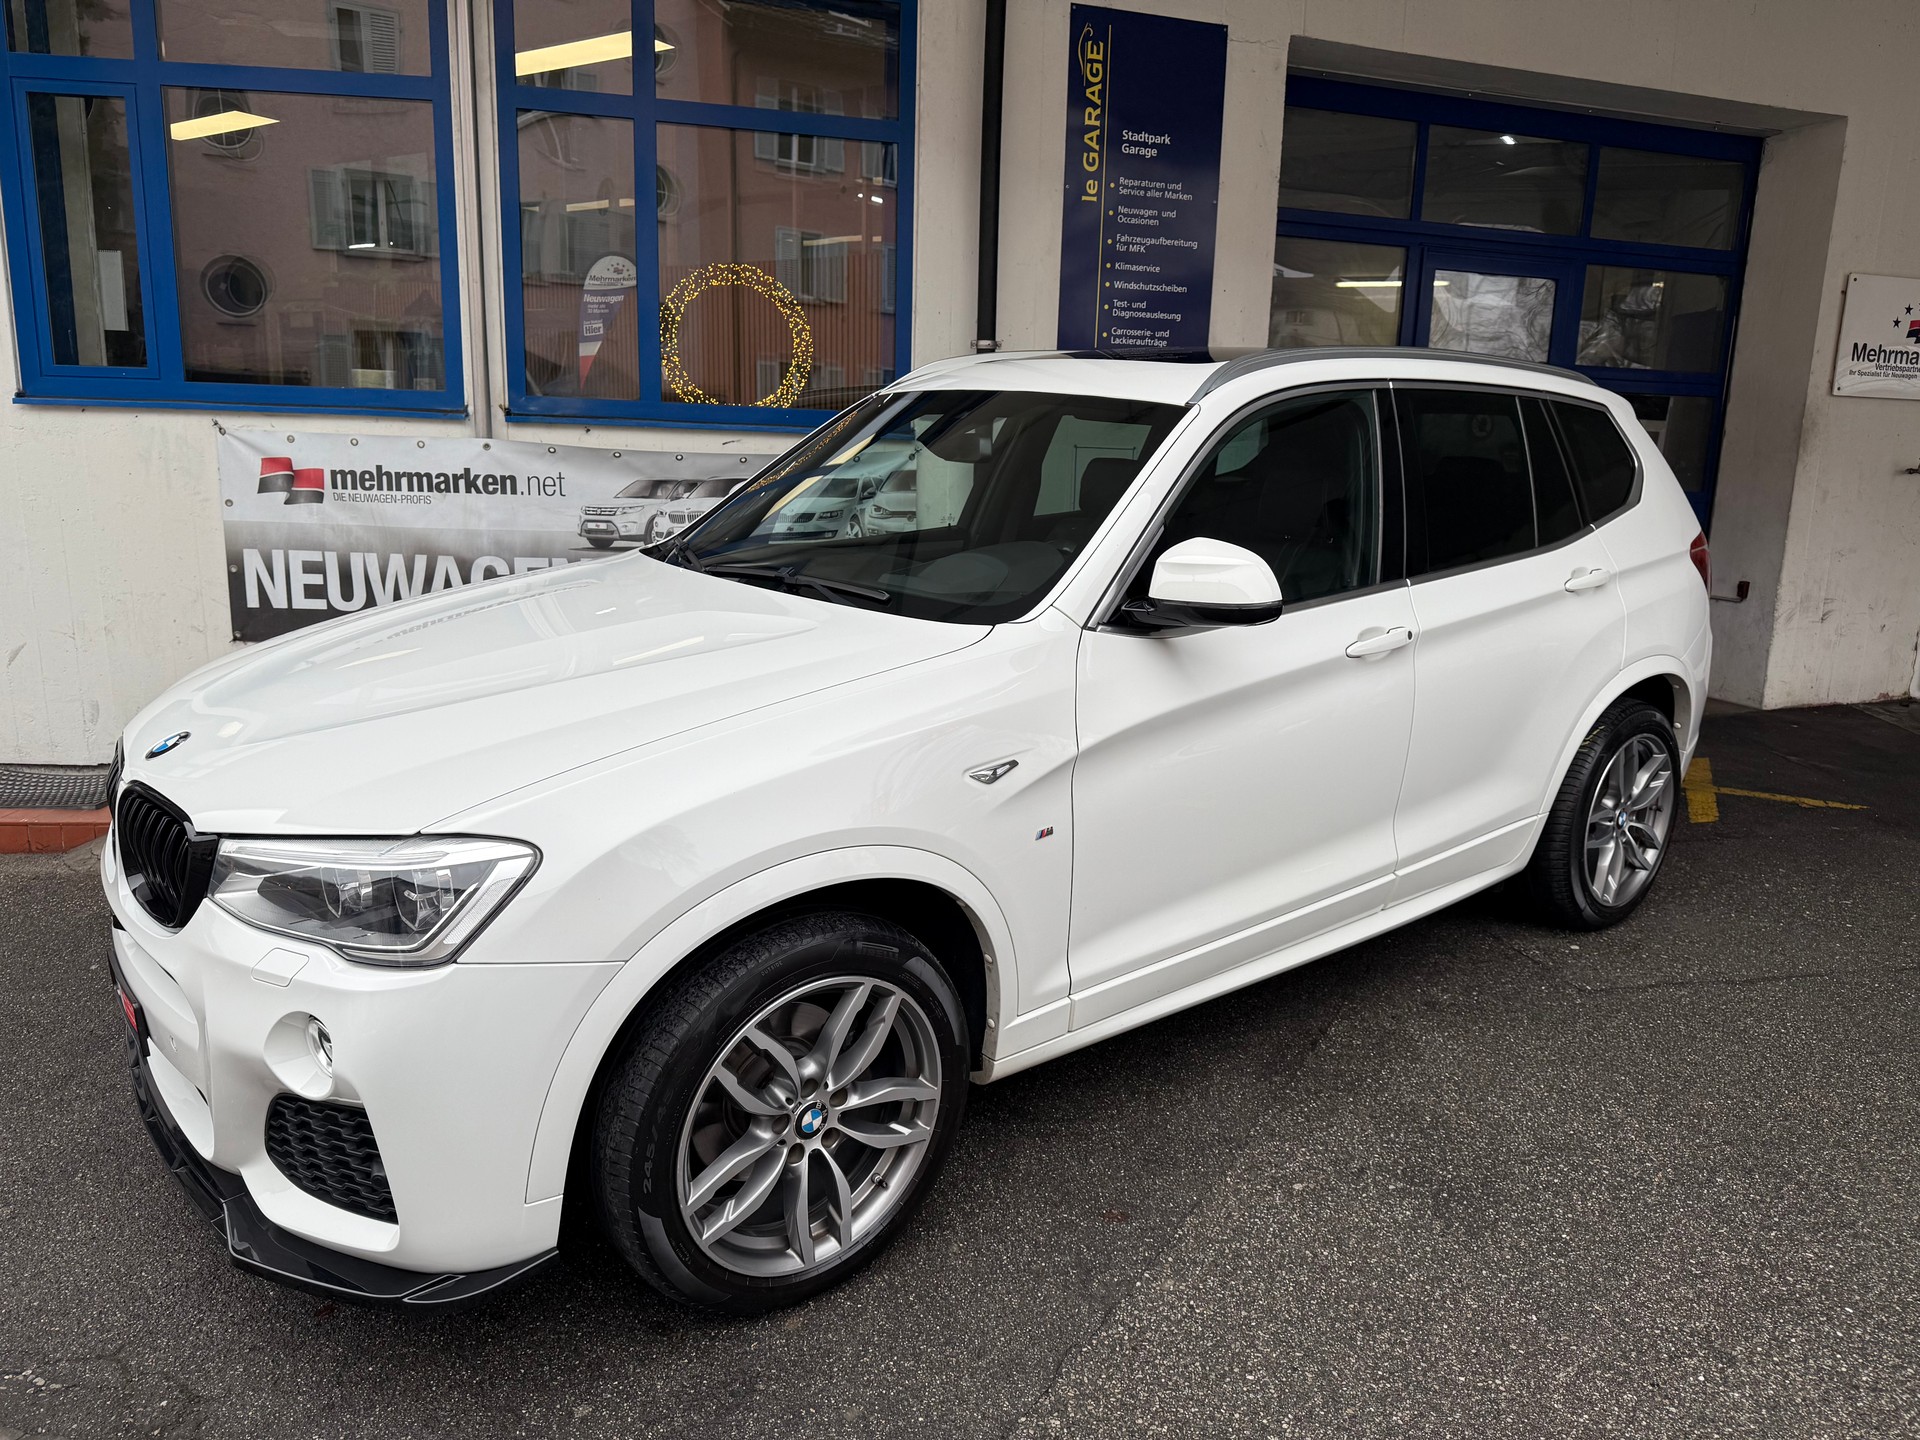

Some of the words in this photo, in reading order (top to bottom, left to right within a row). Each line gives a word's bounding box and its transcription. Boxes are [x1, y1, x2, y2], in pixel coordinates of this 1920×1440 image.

[1083, 40, 1104, 172] GARAGE
[1122, 129, 1171, 145] Stadtpark
[1121, 143, 1158, 158] Garage
[1119, 176, 1165, 189] Reparaturen
[1167, 182, 1182, 190] und
[1081, 179, 1099, 202] le
[1119, 186, 1145, 197] Service
[1146, 189, 1163, 198] aller
[1164, 190, 1193, 201] Marken
[1118, 205, 1158, 217] Neuwagen
[1161, 210, 1176, 218] und
[1117, 214, 1159, 226] Occasionen
[1116, 233, 1198, 250] Fahrzeugaufbereitung
[1116, 243, 1127, 252] für
[1128, 244, 1146, 253] MFK
[1115, 261, 1160, 273] Klimaservice
[1114, 280, 1188, 293] Windschutzscheiben
[583, 293, 625, 304] Neuwagen
[1113, 299, 1130, 308] Test-
[1131, 301, 1147, 309] und
[1112, 308, 1181, 322] Diagnoseauslesung
[584, 325, 602, 335] Hier
[1111, 326, 1154, 337] Carrosserie-
[1155, 329, 1170, 338] und
[1110, 336, 1168, 348] Lackieraufträge
[1851, 342, 1920, 366] Mehrma
[330, 464, 567, 498] mehrmarken.net
[333, 491, 347, 502] DIE
[348, 492, 432, 505] NEUWAGEN-PROFIS
